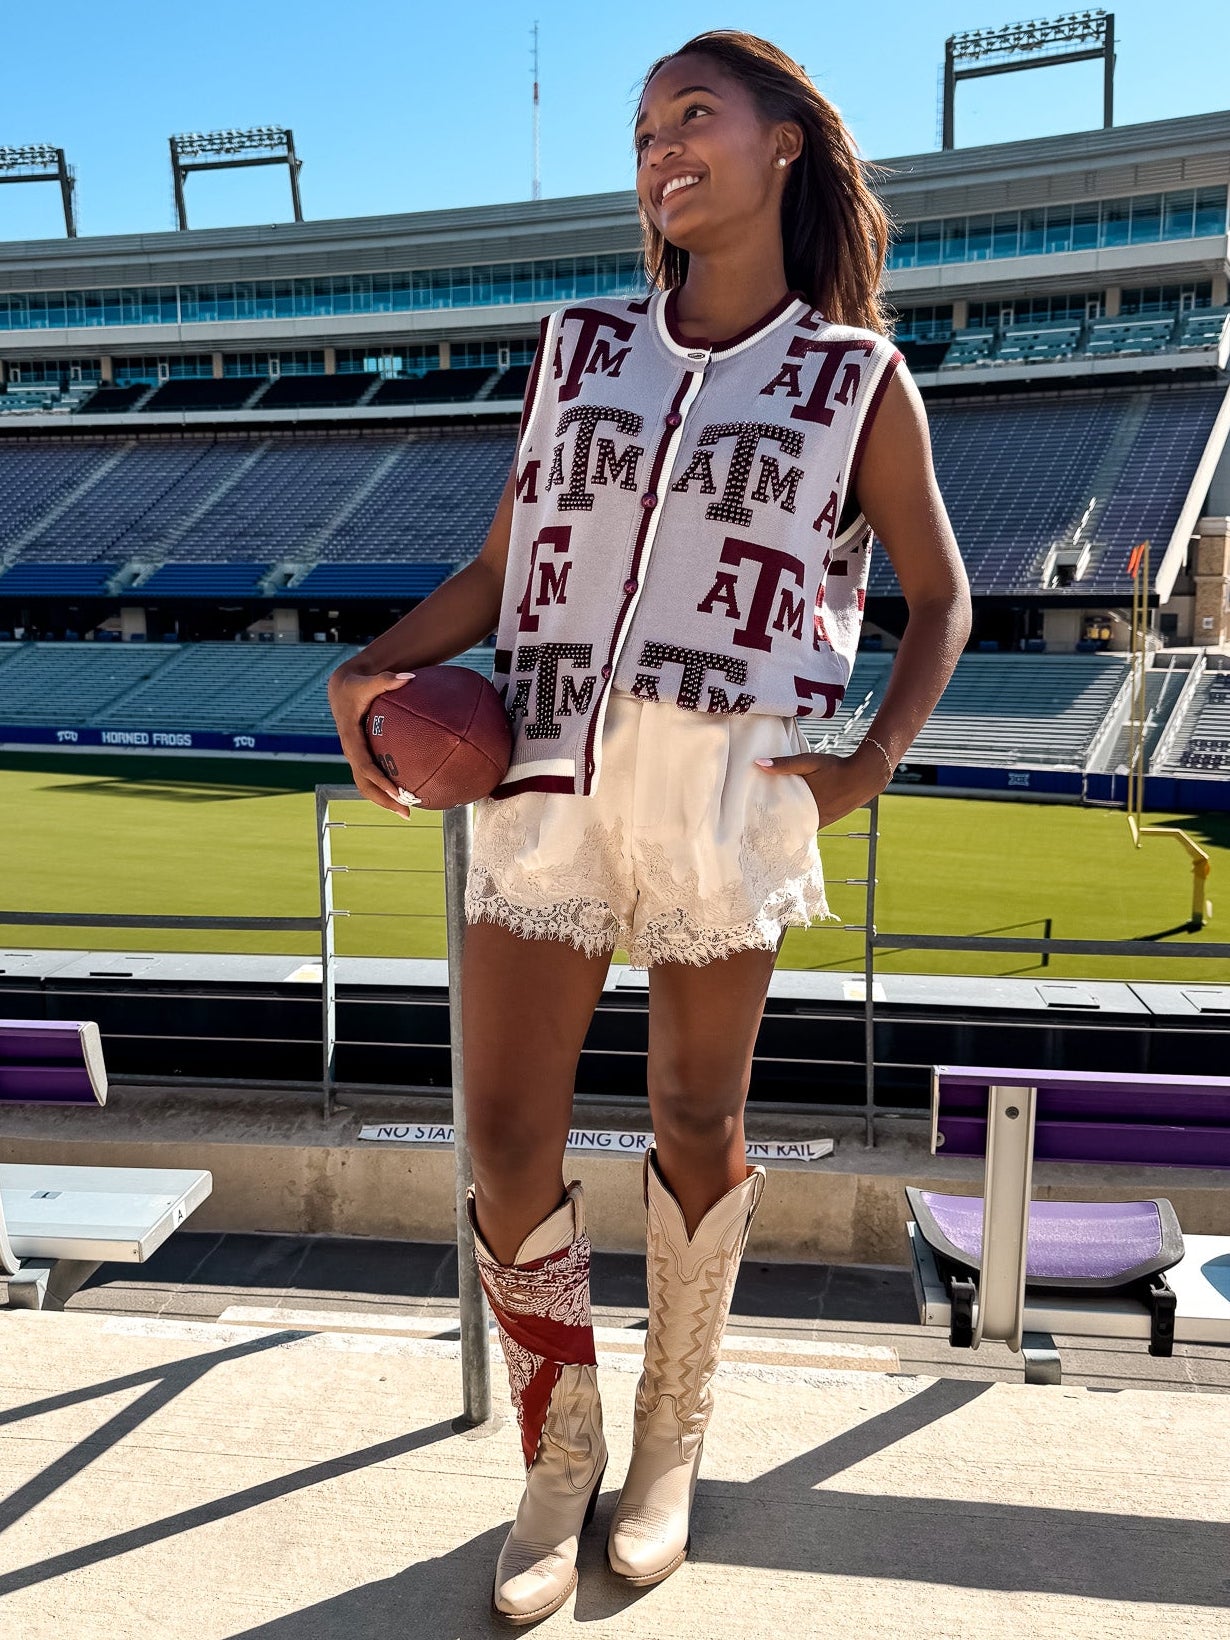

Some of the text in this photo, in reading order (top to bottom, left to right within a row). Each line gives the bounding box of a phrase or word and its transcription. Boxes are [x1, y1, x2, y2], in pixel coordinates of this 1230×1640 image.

[671, 420, 805, 527] ATM
[696, 536, 806, 653] ATM
[57, 730, 79, 742] TCU
[102, 731, 192, 746] HORNED FROGS
[233, 736, 256, 748] TCU
[377, 1127, 410, 1138] NO
[619, 1134, 646, 1149] OR
[777, 1144, 816, 1156] RAIL
[177, 1209, 184, 1223] A
